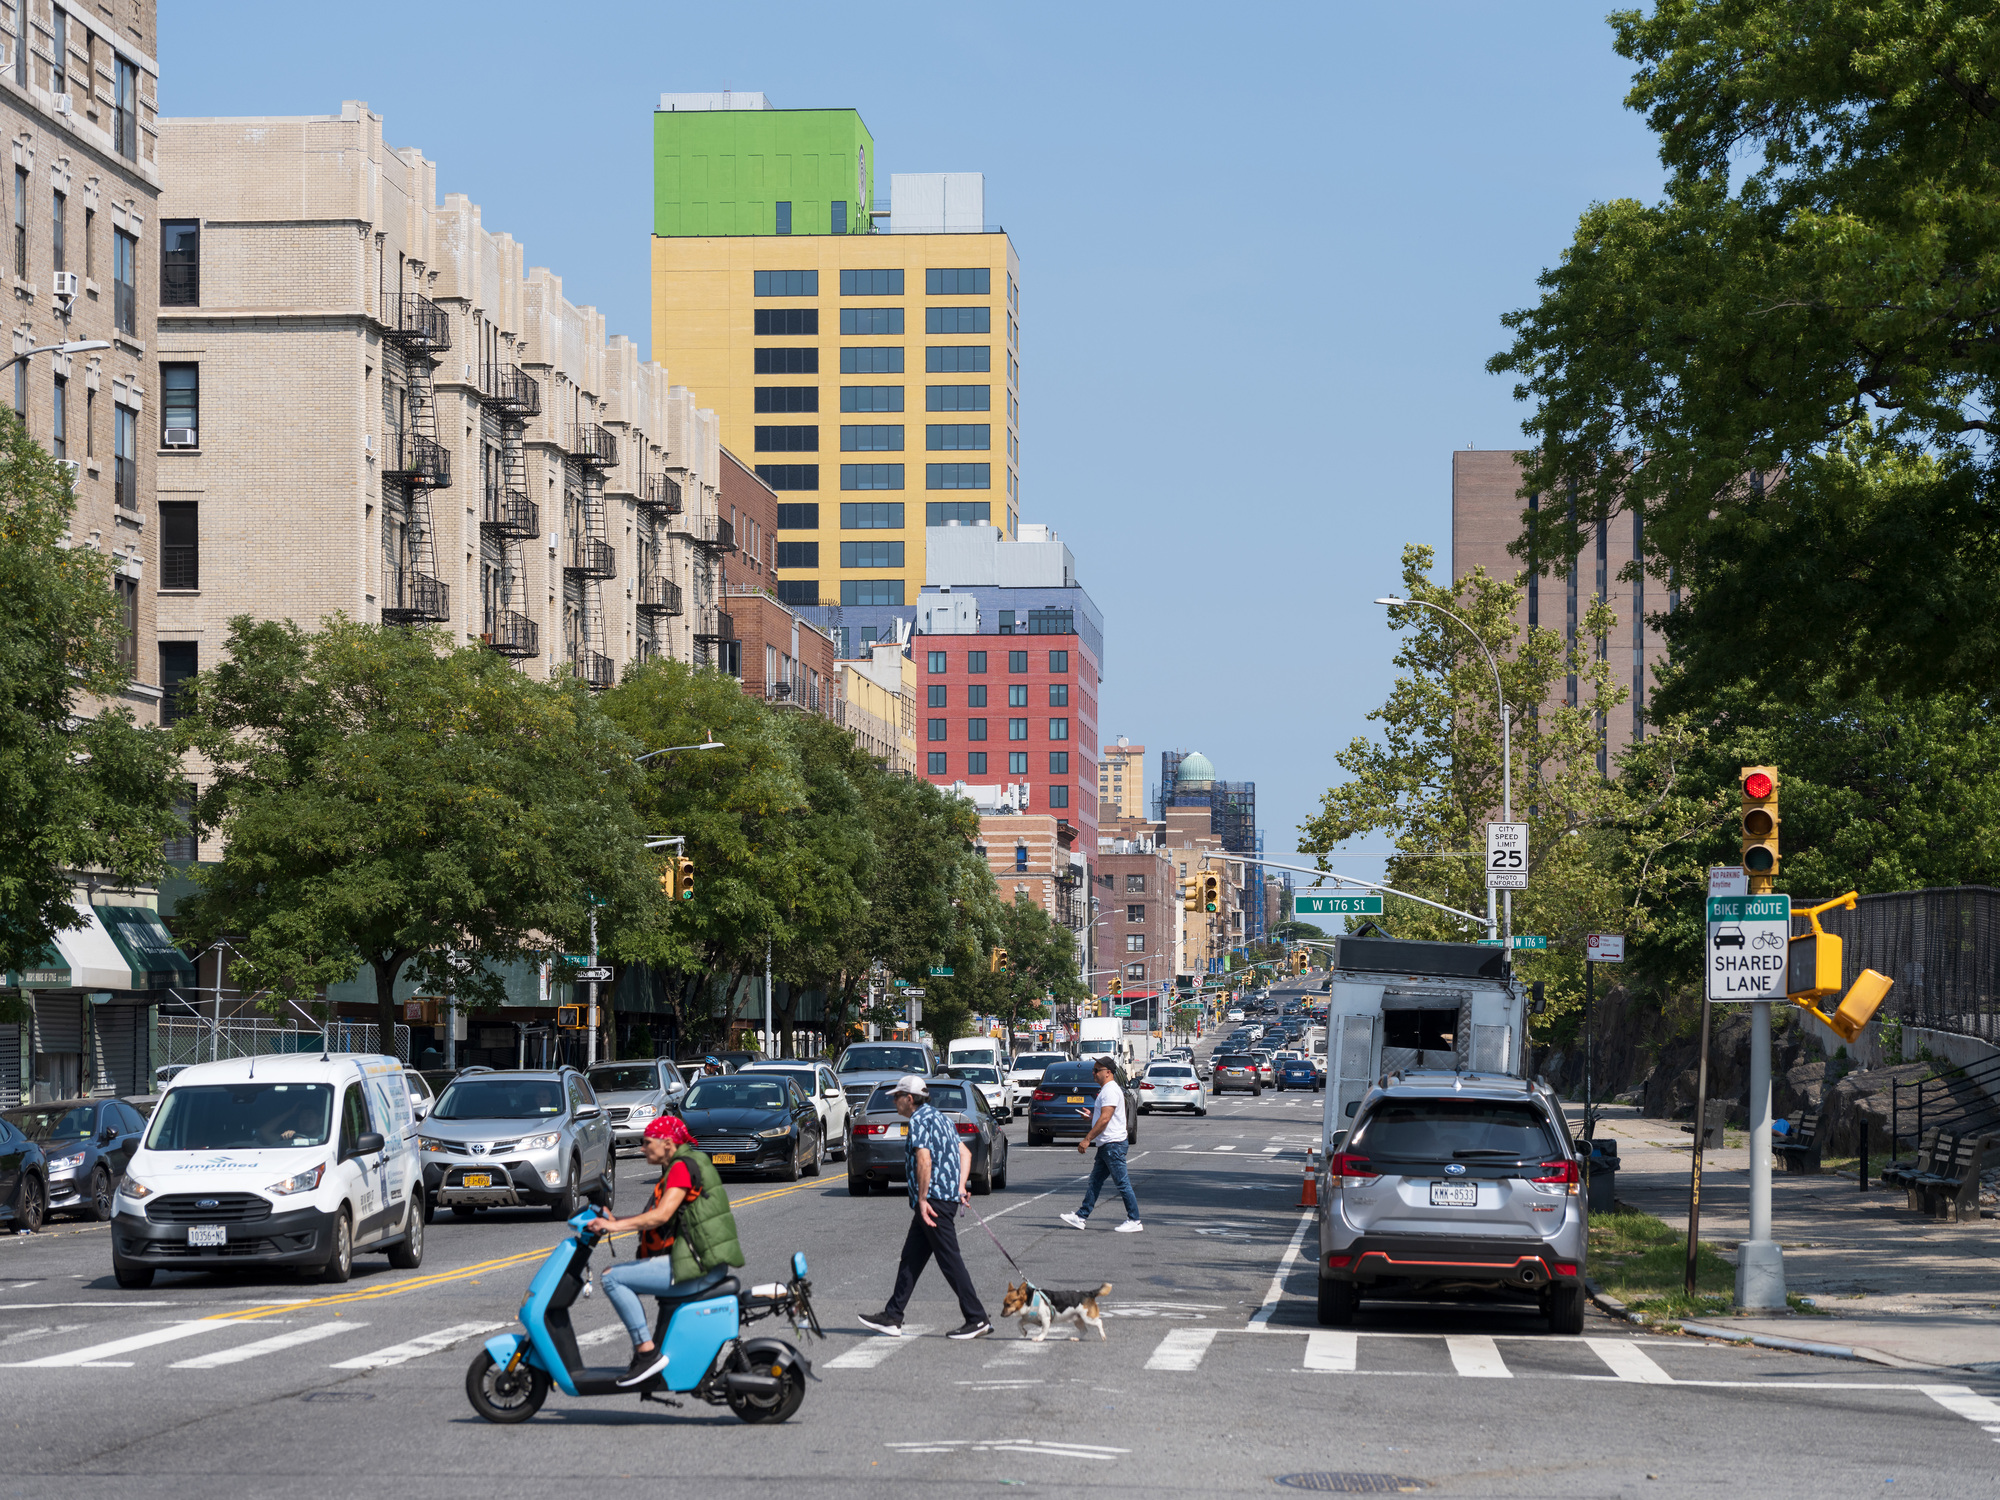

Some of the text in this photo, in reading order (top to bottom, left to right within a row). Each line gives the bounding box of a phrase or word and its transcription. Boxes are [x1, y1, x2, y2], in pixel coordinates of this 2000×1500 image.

[1492, 850, 1522, 868] 25
[1720, 871, 1740, 879] PARKING
[1712, 881, 1731, 890] Anytime
[1312, 899, 1365, 911] W 176 St
[1714, 902, 1783, 916] BIKE ROUTE
[1515, 938, 1522, 947] W
[1525, 937, 1536, 947] 176
[1715, 955, 1783, 971] SHARED
[936, 966, 944, 974] St
[1727, 976, 1772, 991] LANE
